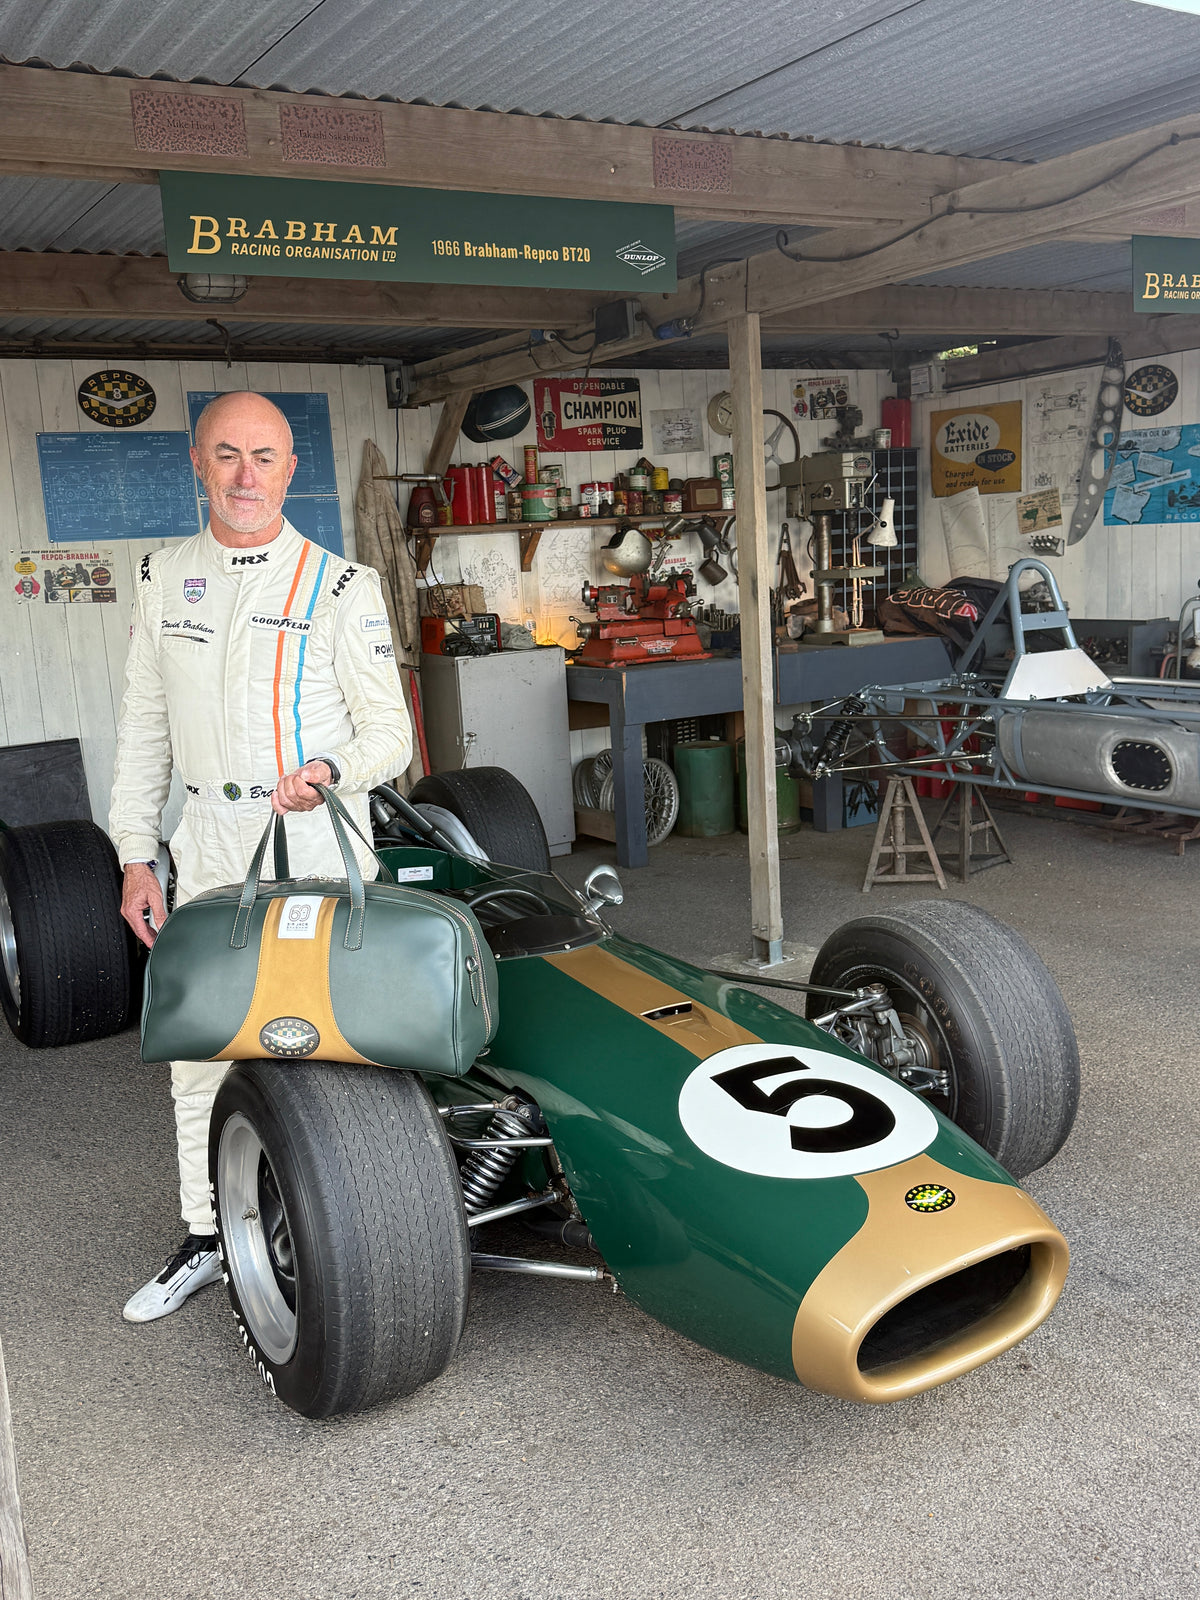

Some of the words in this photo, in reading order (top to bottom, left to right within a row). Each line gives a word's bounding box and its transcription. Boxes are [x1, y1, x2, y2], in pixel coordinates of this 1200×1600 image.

[166, 118, 189, 129] Mike
[187, 215, 399, 255] BRABHAM
[231, 243, 281, 257] RACING
[285, 245, 379, 261] ORGANISATION
[431, 240, 460, 256] 1966
[464, 241, 559, 263] Brabham-Repco
[562, 246, 591, 263] BT20
[1163, 290, 1189, 300] RACING
[88, 373, 145, 387] REPCO
[573, 382, 625, 391] DEPENDABLE
[113, 388, 122, 399] 8
[82, 401, 154, 425] BRABHAM
[564, 400, 637, 419] CHAMPION
[578, 427, 603, 435] SPARK
[606, 427, 627, 435] PLUG
[945, 420, 989, 444] Exide
[587, 438, 620, 446] SERVICE
[944, 442, 990, 453] BATTERIES
[988, 453, 1013, 463] STOCK
[945, 469, 975, 479] Charged
[41, 552, 100, 561] REPCO-BRABHAM
[231, 552, 269, 566] HRX
[331, 565, 359, 597] HRX
[161, 619, 182, 629] David
[183, 619, 215, 635] Brabham
[251, 616, 311, 631] GOODYEAR
[250, 785, 276, 798] Bra
[272, 1021, 309, 1031] REPCO
[263, 1038, 315, 1055] BRABHAM
[710, 1056, 896, 1153] 5
